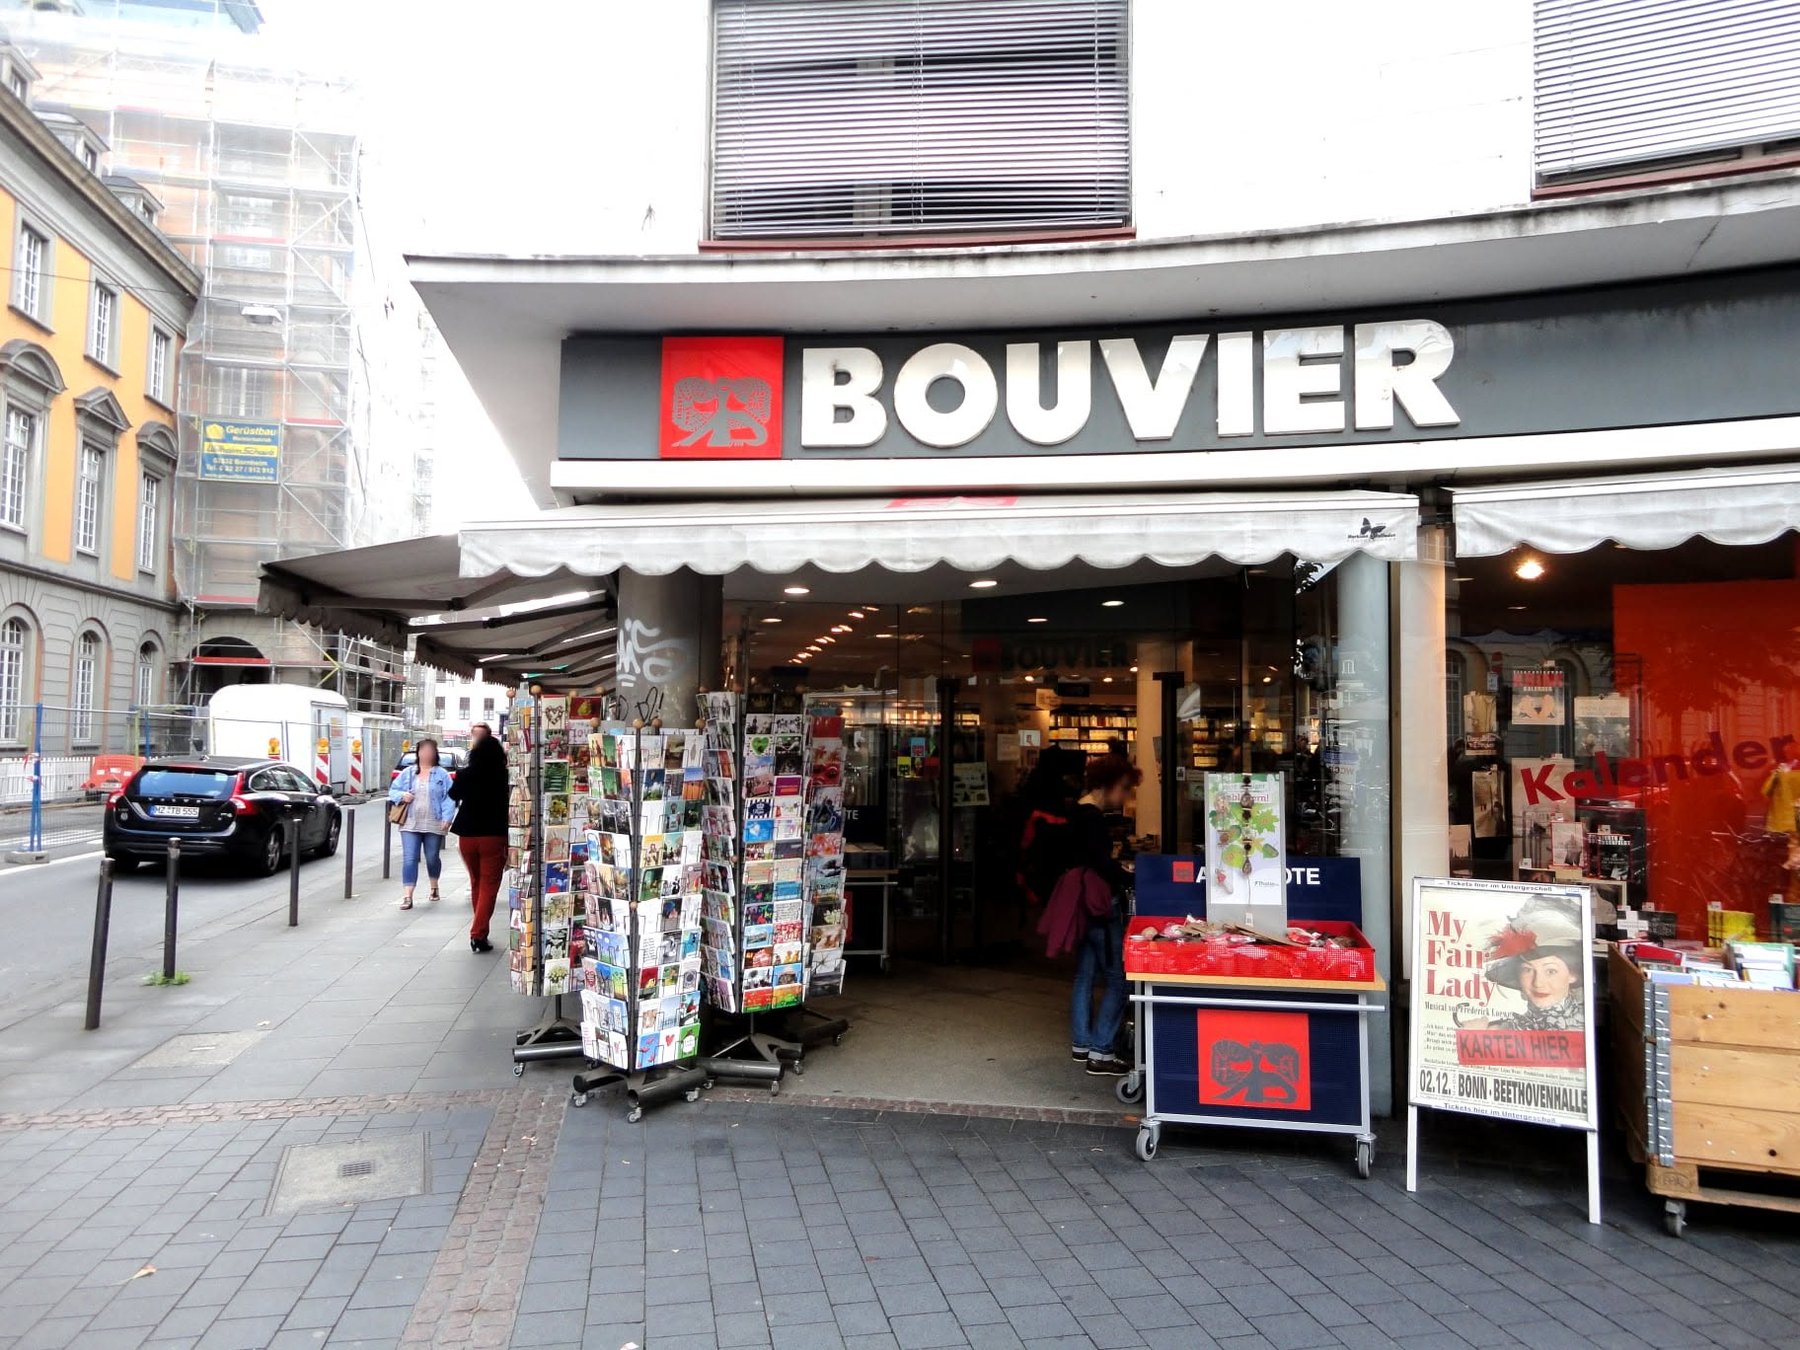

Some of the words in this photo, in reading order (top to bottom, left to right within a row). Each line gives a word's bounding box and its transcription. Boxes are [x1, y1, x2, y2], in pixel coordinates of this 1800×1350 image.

[801, 319, 1461, 448] BOUVIER
[226, 425, 276, 436] Gerüstbau
[1521, 731, 1795, 806] Kalender
[182, 808, 198, 816] 555
[1426, 910, 1467, 943] My
[1426, 939, 1484, 970] Fair
[1425, 969, 1496, 1006] Lady
[1425, 1001, 1447, 1011] Musical
[1459, 1005, 1490, 1016] Frederick
[1460, 1033, 1526, 1059] KARTEN
[1530, 1035, 1571, 1061] HIER
[1420, 1069, 1452, 1095] 02.12.
[1458, 1074, 1488, 1100] BONN
[1493, 1078, 1588, 1114] BEETHOVENHALLE
[1444, 1102, 1472, 1112] Tickets
